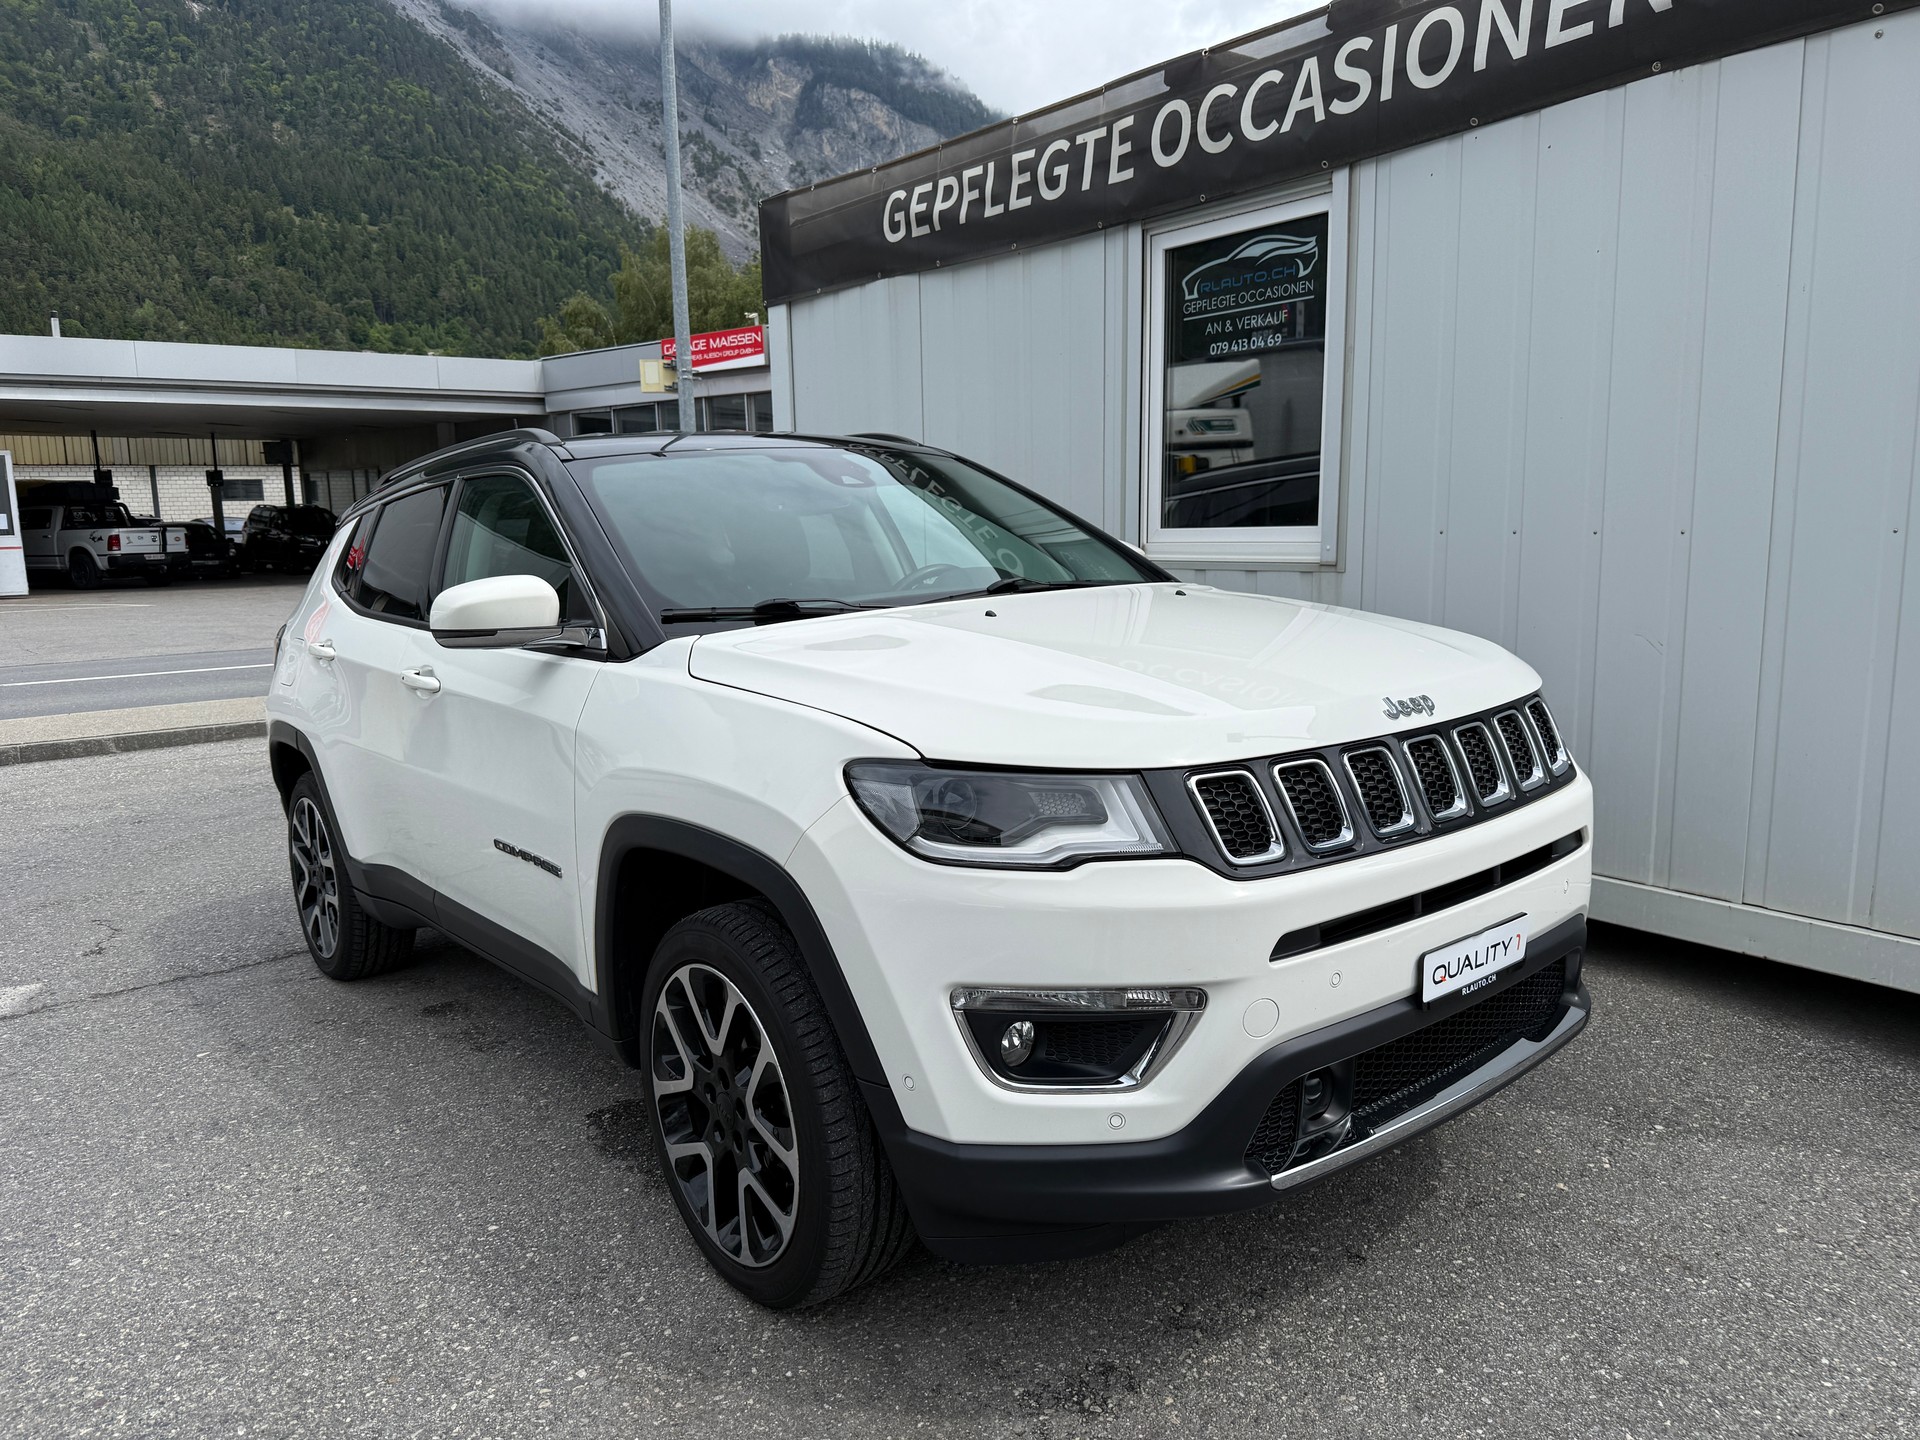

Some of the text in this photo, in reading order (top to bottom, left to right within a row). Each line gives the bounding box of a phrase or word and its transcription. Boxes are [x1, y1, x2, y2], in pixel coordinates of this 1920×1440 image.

[882, 115, 1135, 243] GEPFLEGTE
[1200, 265, 1296, 293] RLAUTO.CH
[1183, 280, 1314, 314] GEPFLEGTE OCCASIONEN
[1205, 310, 1289, 336] AN & VERKAUF
[664, 332, 761, 355] GAGE MAISSEN
[1210, 333, 1282, 356] 079 413 04 69
[1382, 695, 1436, 720] Jeep
[1432, 936, 1513, 985] QUALITY
[1461, 974, 1497, 995] RLAUTO.CH
